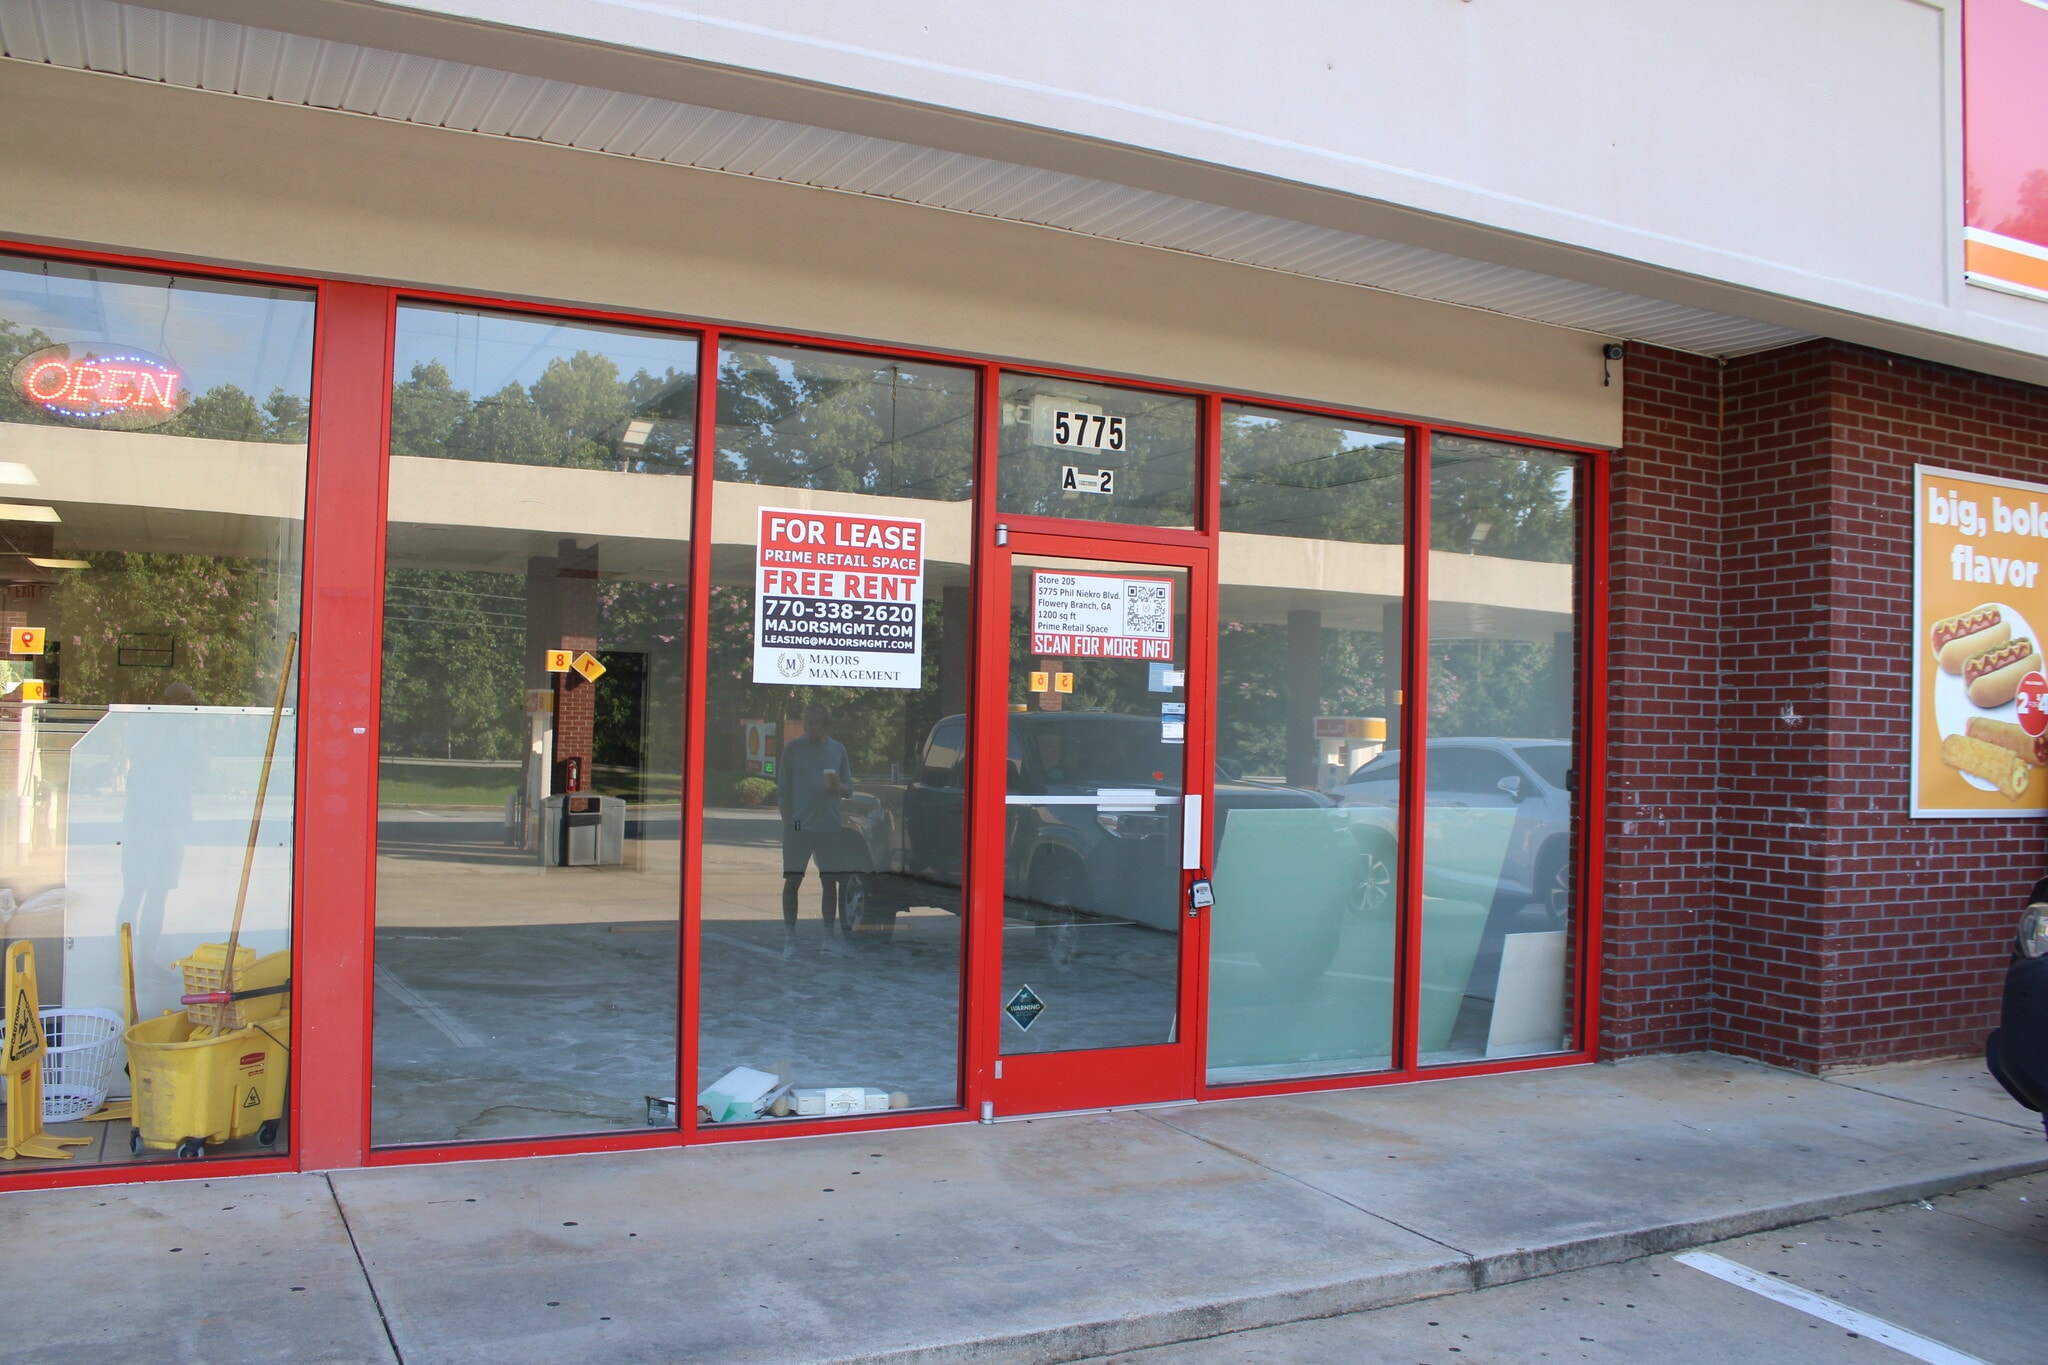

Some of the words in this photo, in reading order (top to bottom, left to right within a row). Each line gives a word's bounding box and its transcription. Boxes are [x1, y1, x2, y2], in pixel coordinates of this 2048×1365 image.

[29, 362, 178, 408] OPEN
[1055, 411, 1123, 450] 5775
[1928, 486, 1987, 537] big,
[770, 517, 826, 545] FOR
[835, 522, 917, 551] LEASE
[764, 549, 812, 564] PRIME
[816, 553, 868, 567] RETAIL
[872, 556, 917, 571] SPACE
[1951, 544, 2039, 588] flavor
[763, 569, 833, 597] FREE
[844, 574, 917, 601] RENT
[1038, 576, 1059, 585] Store
[1061, 577, 1076, 586] 205
[16, 585, 35, 598] EXIT
[1038, 588, 1058, 596] 5775
[1060, 588, 1074, 597] Phil
[1076, 590, 1101, 599] Niekro
[1103, 591, 1121, 600] Blvd.
[765, 599, 913, 622] 770-338-2620
[1038, 599, 1068, 609] Flowery
[1070, 601, 1099, 611] Branch,
[1101, 602, 1112, 611] GA
[1038, 611, 1057, 619] 1200
[1059, 613, 1068, 621] sq
[1070, 611, 1076, 620] ft
[765, 619, 913, 637] MAJORSMGMT.COM
[1038, 623, 1060, 631] Prime
[1062, 624, 1084, 632] Retail
[1086, 625, 1109, 635] Space
[764, 634, 913, 650] LEASING@MAJORSMGMT.COM
[1035, 634, 1070, 654] SCAN
[1074, 636, 1100, 655] FOR
[1103, 638, 1138, 657] MORE
[1142, 640, 1170, 659] INFO
[785, 658, 796, 671] M
[809, 654, 860, 666] MAJORS
[808, 668, 901, 681] MANAGEMENT
[2017, 691, 2029, 714] 2
[11, 1006, 21, 1045] CAUTION
